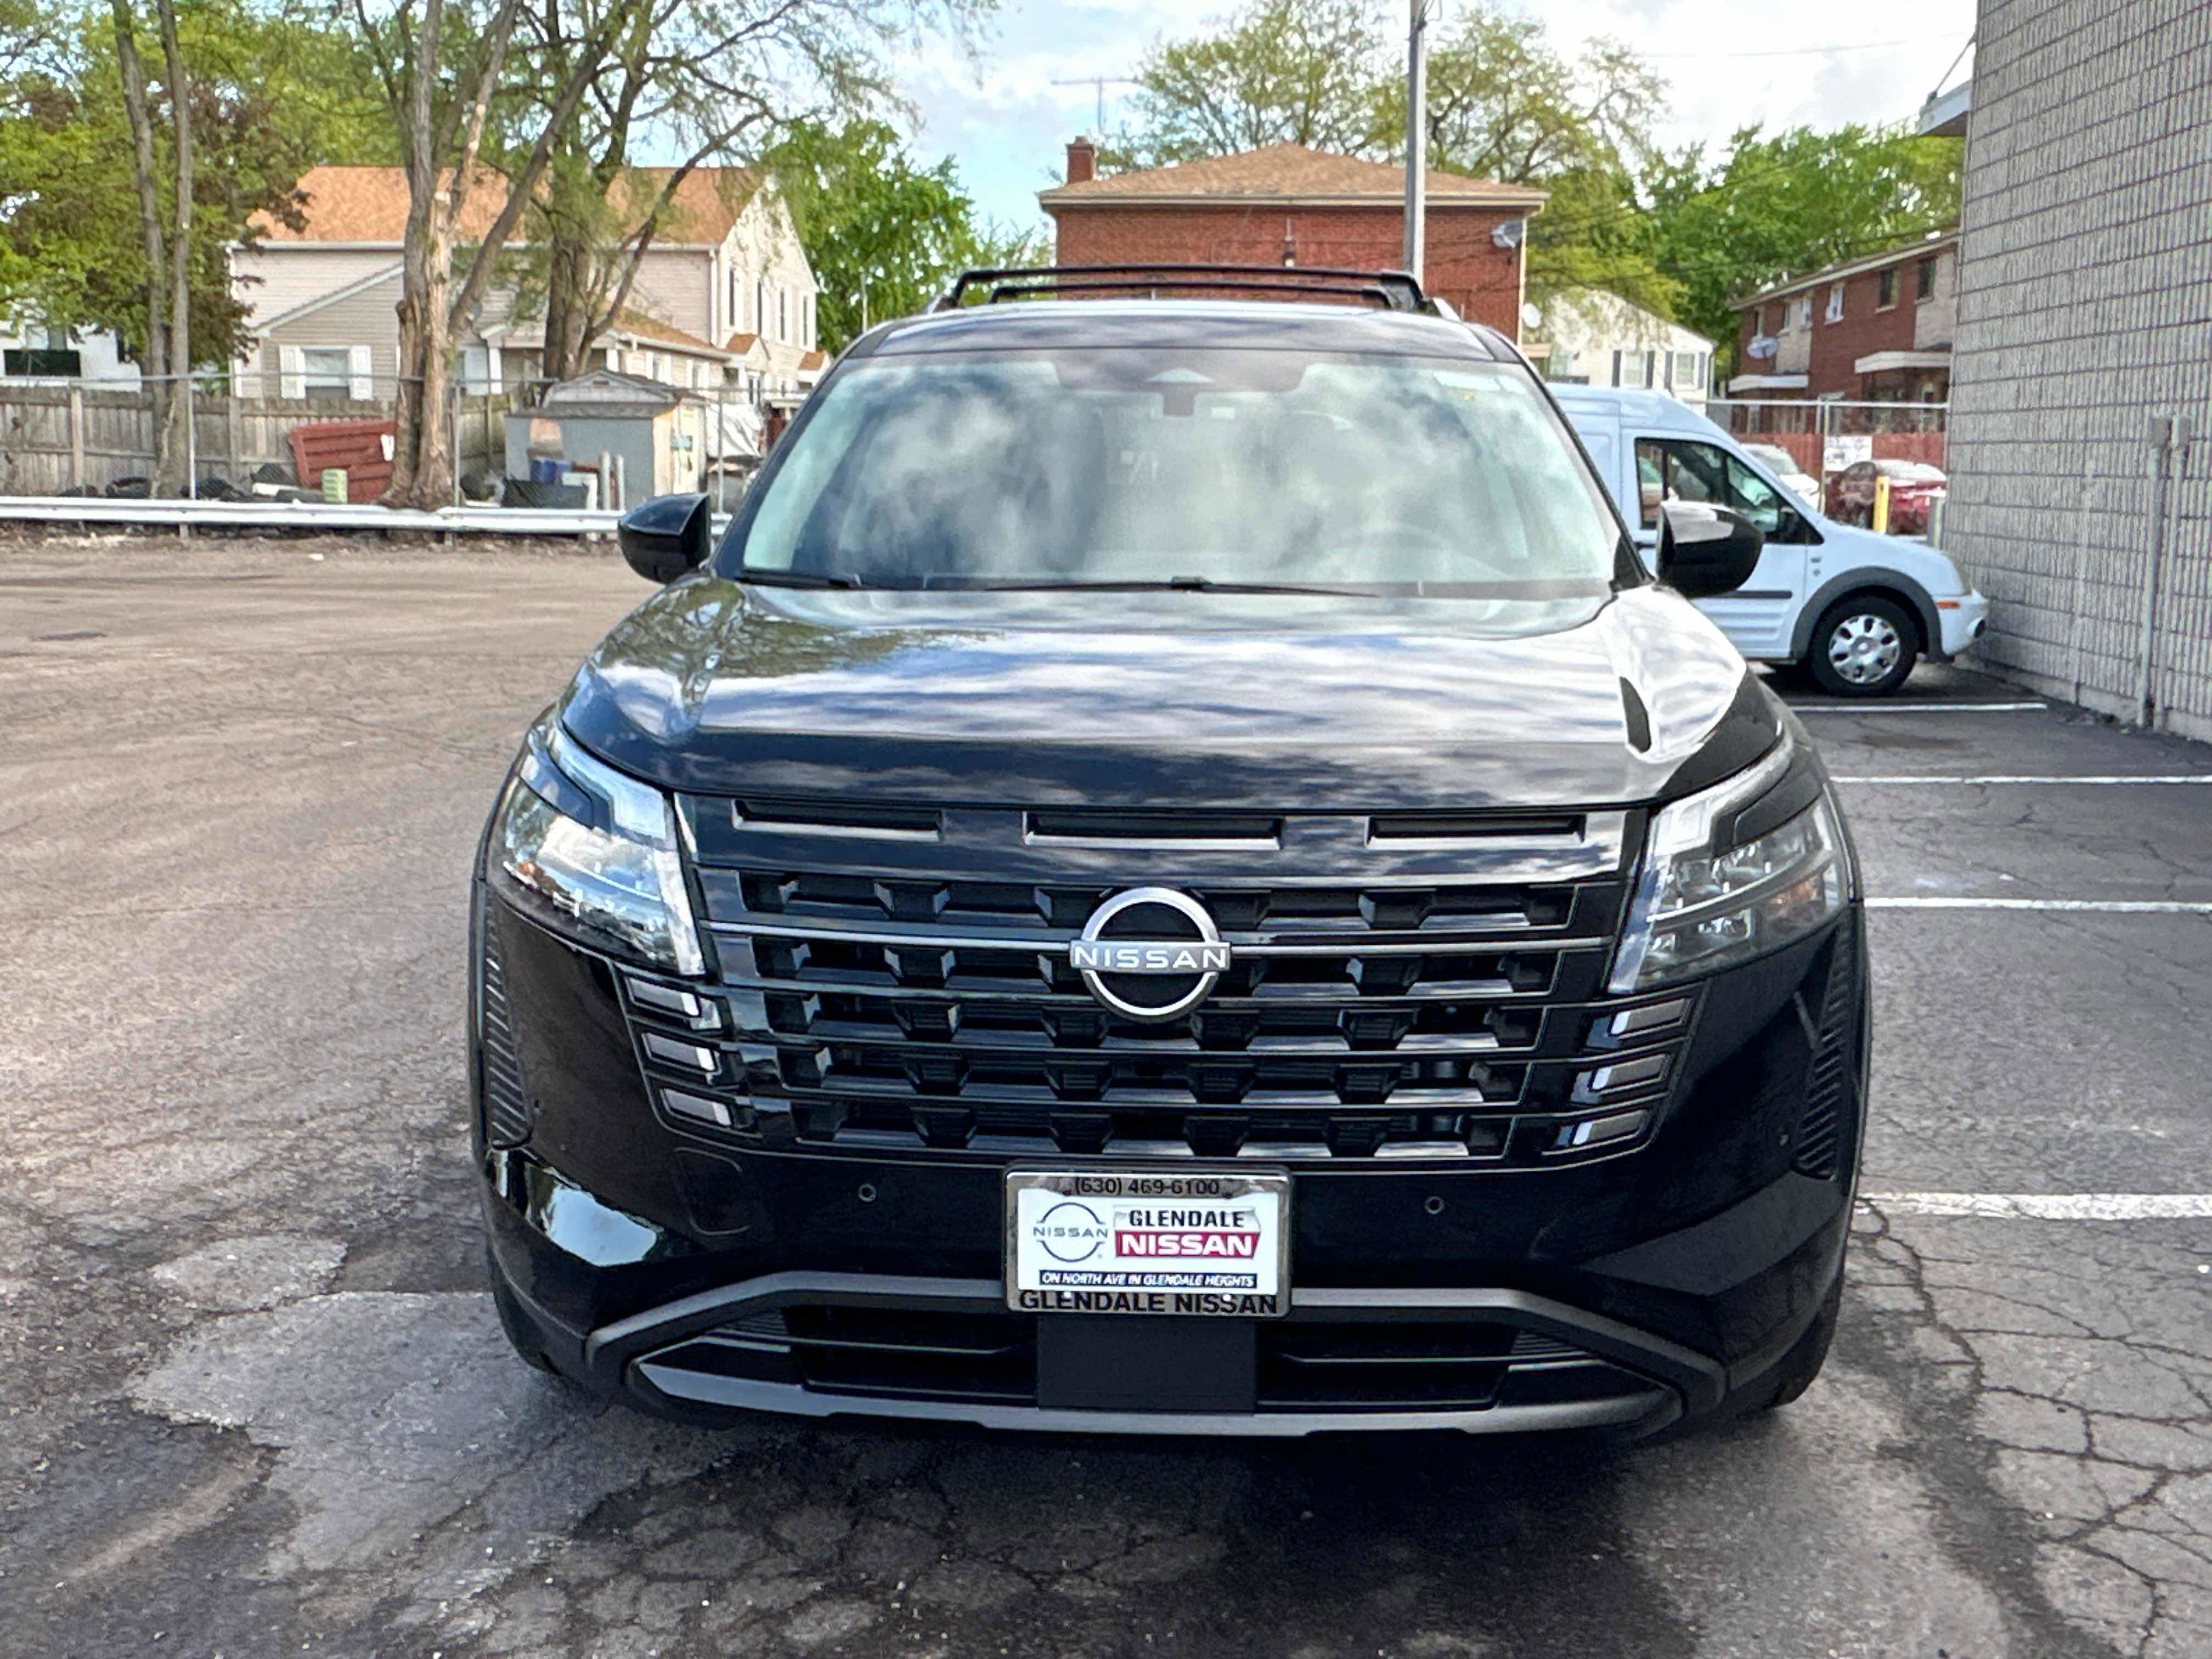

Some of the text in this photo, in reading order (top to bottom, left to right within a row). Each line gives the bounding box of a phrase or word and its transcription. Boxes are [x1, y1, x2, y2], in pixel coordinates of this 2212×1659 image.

[1075, 946, 1226, 968] NISSAN
[1075, 1177, 1220, 1195] (630) 469-6100
[1129, 1210, 1245, 1228] GLENDALE
[1032, 1226, 1109, 1238] NISSAN
[1121, 1234, 1252, 1256] NISSAN
[1042, 1272, 1254, 1287] ON NORTH AVE IN GLENDALE HEIGHTS
[1018, 1290, 1278, 1314] GLENDALE NISSAN
